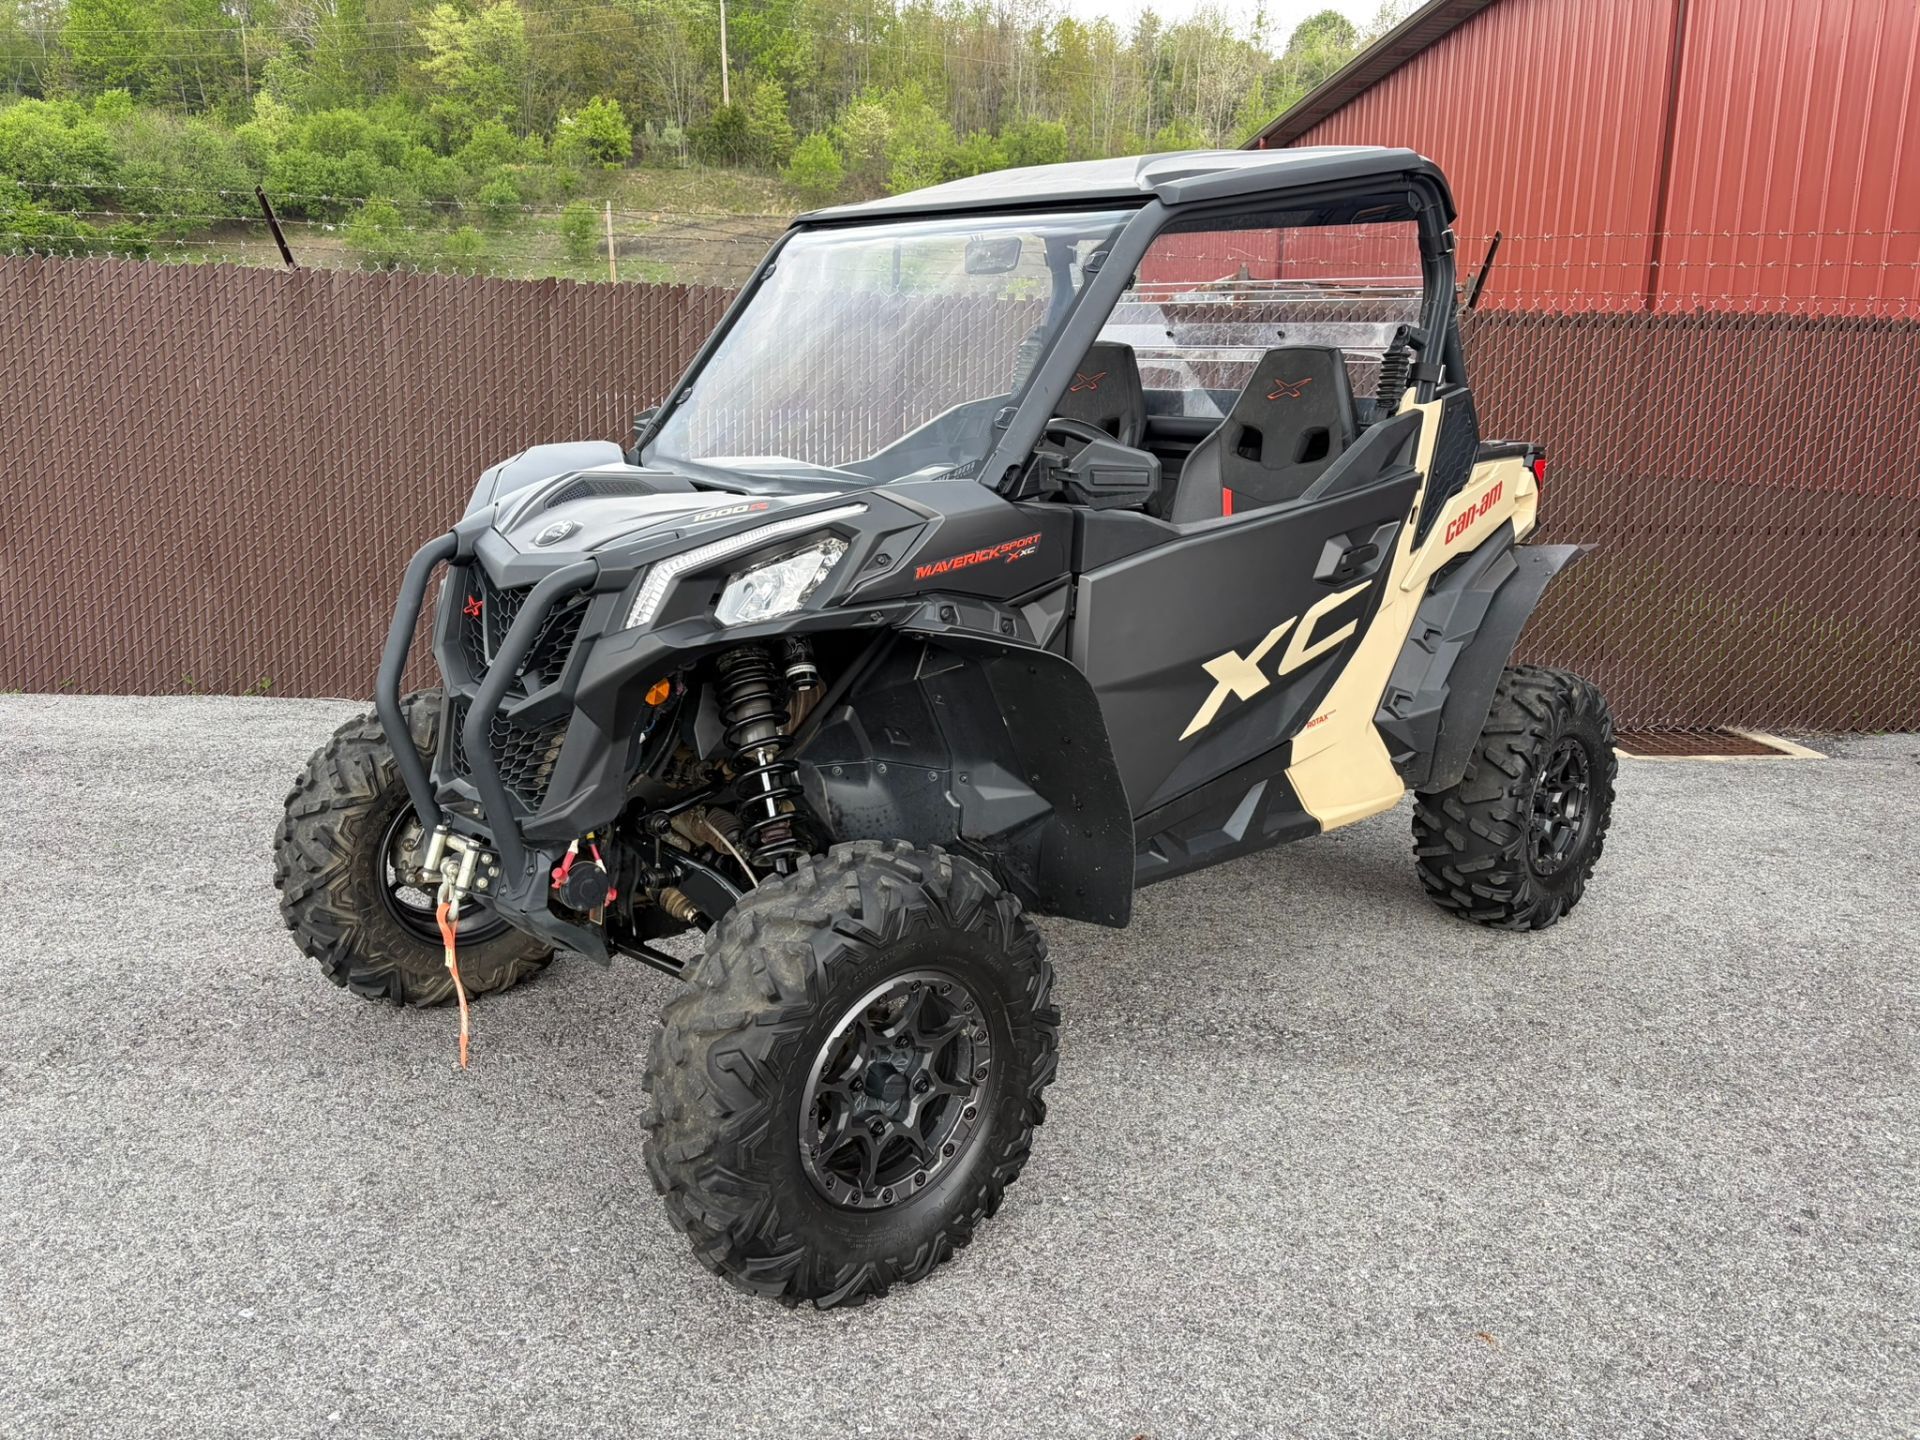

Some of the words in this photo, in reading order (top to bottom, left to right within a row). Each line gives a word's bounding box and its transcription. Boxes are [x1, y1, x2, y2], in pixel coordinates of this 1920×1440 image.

[693, 502, 769, 522] 1000R
[1445, 480, 1503, 545] can-am
[915, 546, 1001, 580] MAVERICK
[1000, 533, 1042, 553] SPORT
[1178, 579, 1373, 741] XC
[1306, 714, 1329, 729] ROTAX
